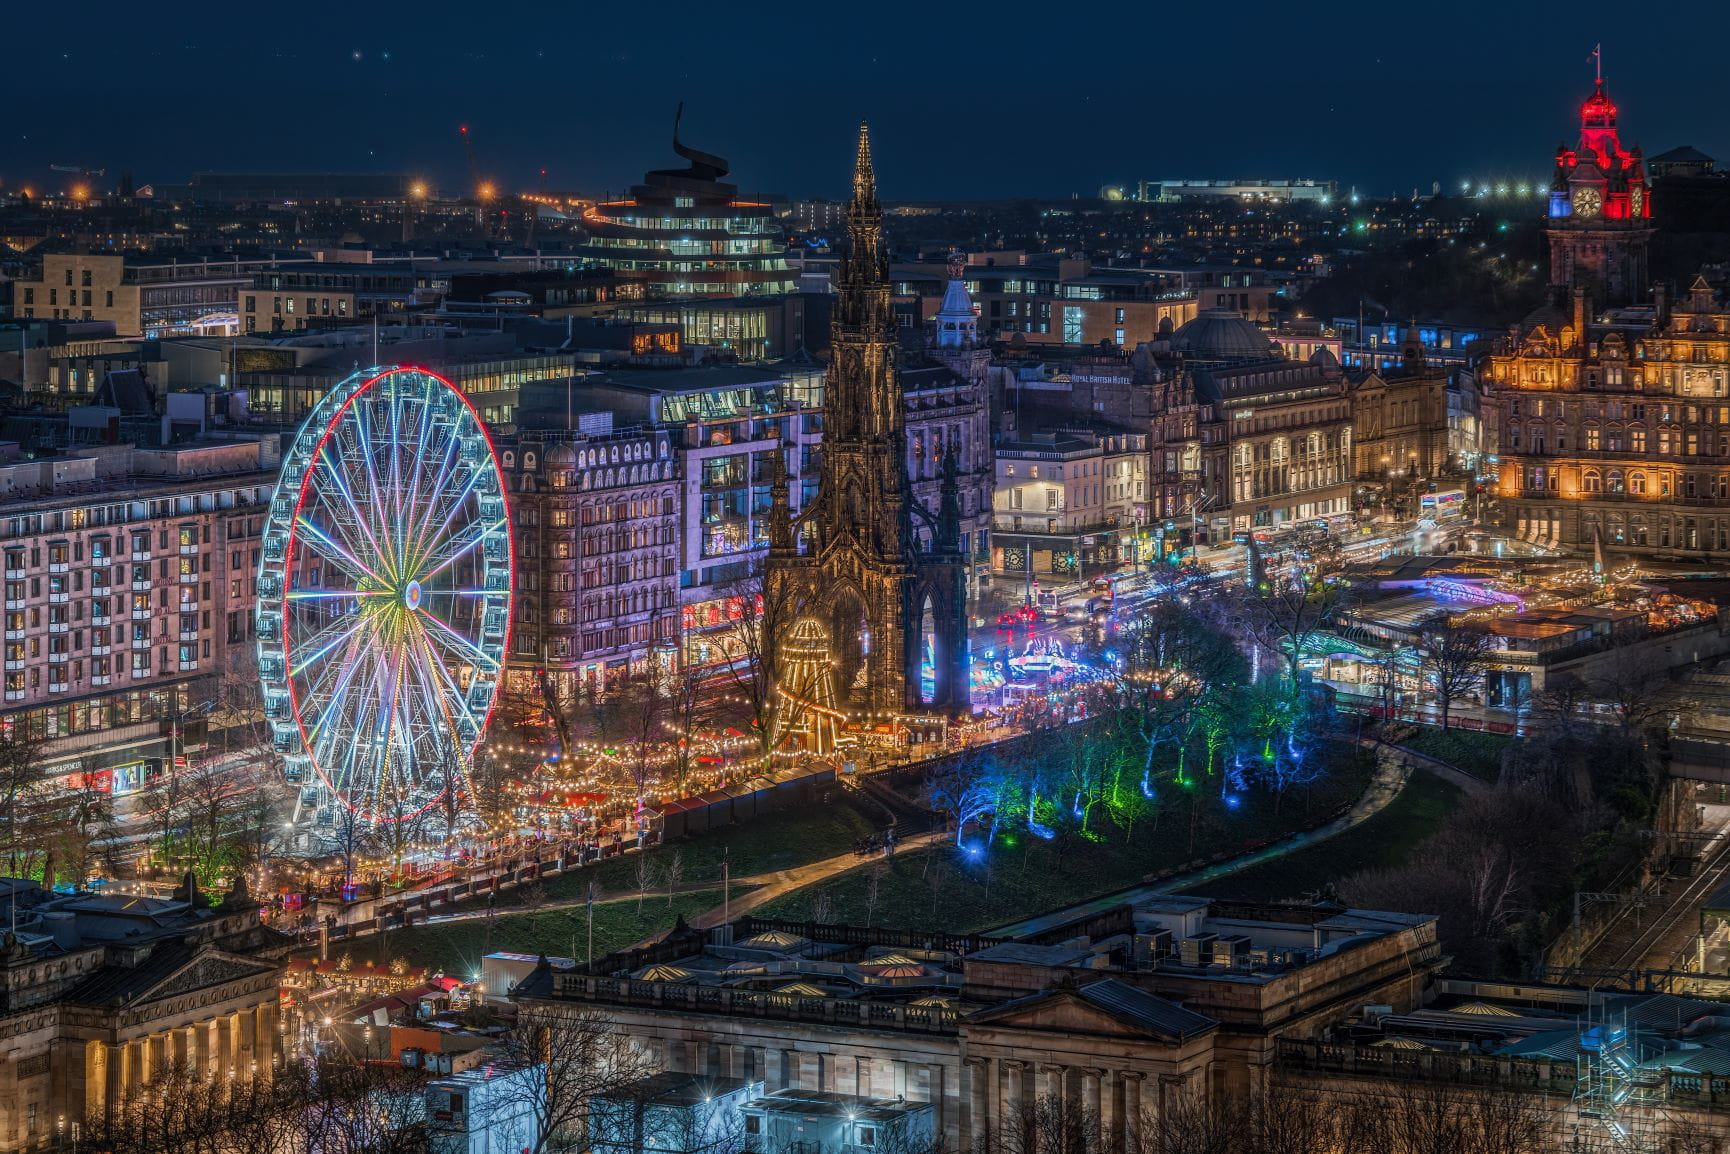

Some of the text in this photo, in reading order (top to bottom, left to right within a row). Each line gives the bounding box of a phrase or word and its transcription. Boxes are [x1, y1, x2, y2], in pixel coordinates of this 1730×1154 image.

[1072, 374, 1131, 385] ROYAL BRITISH HOTEL
